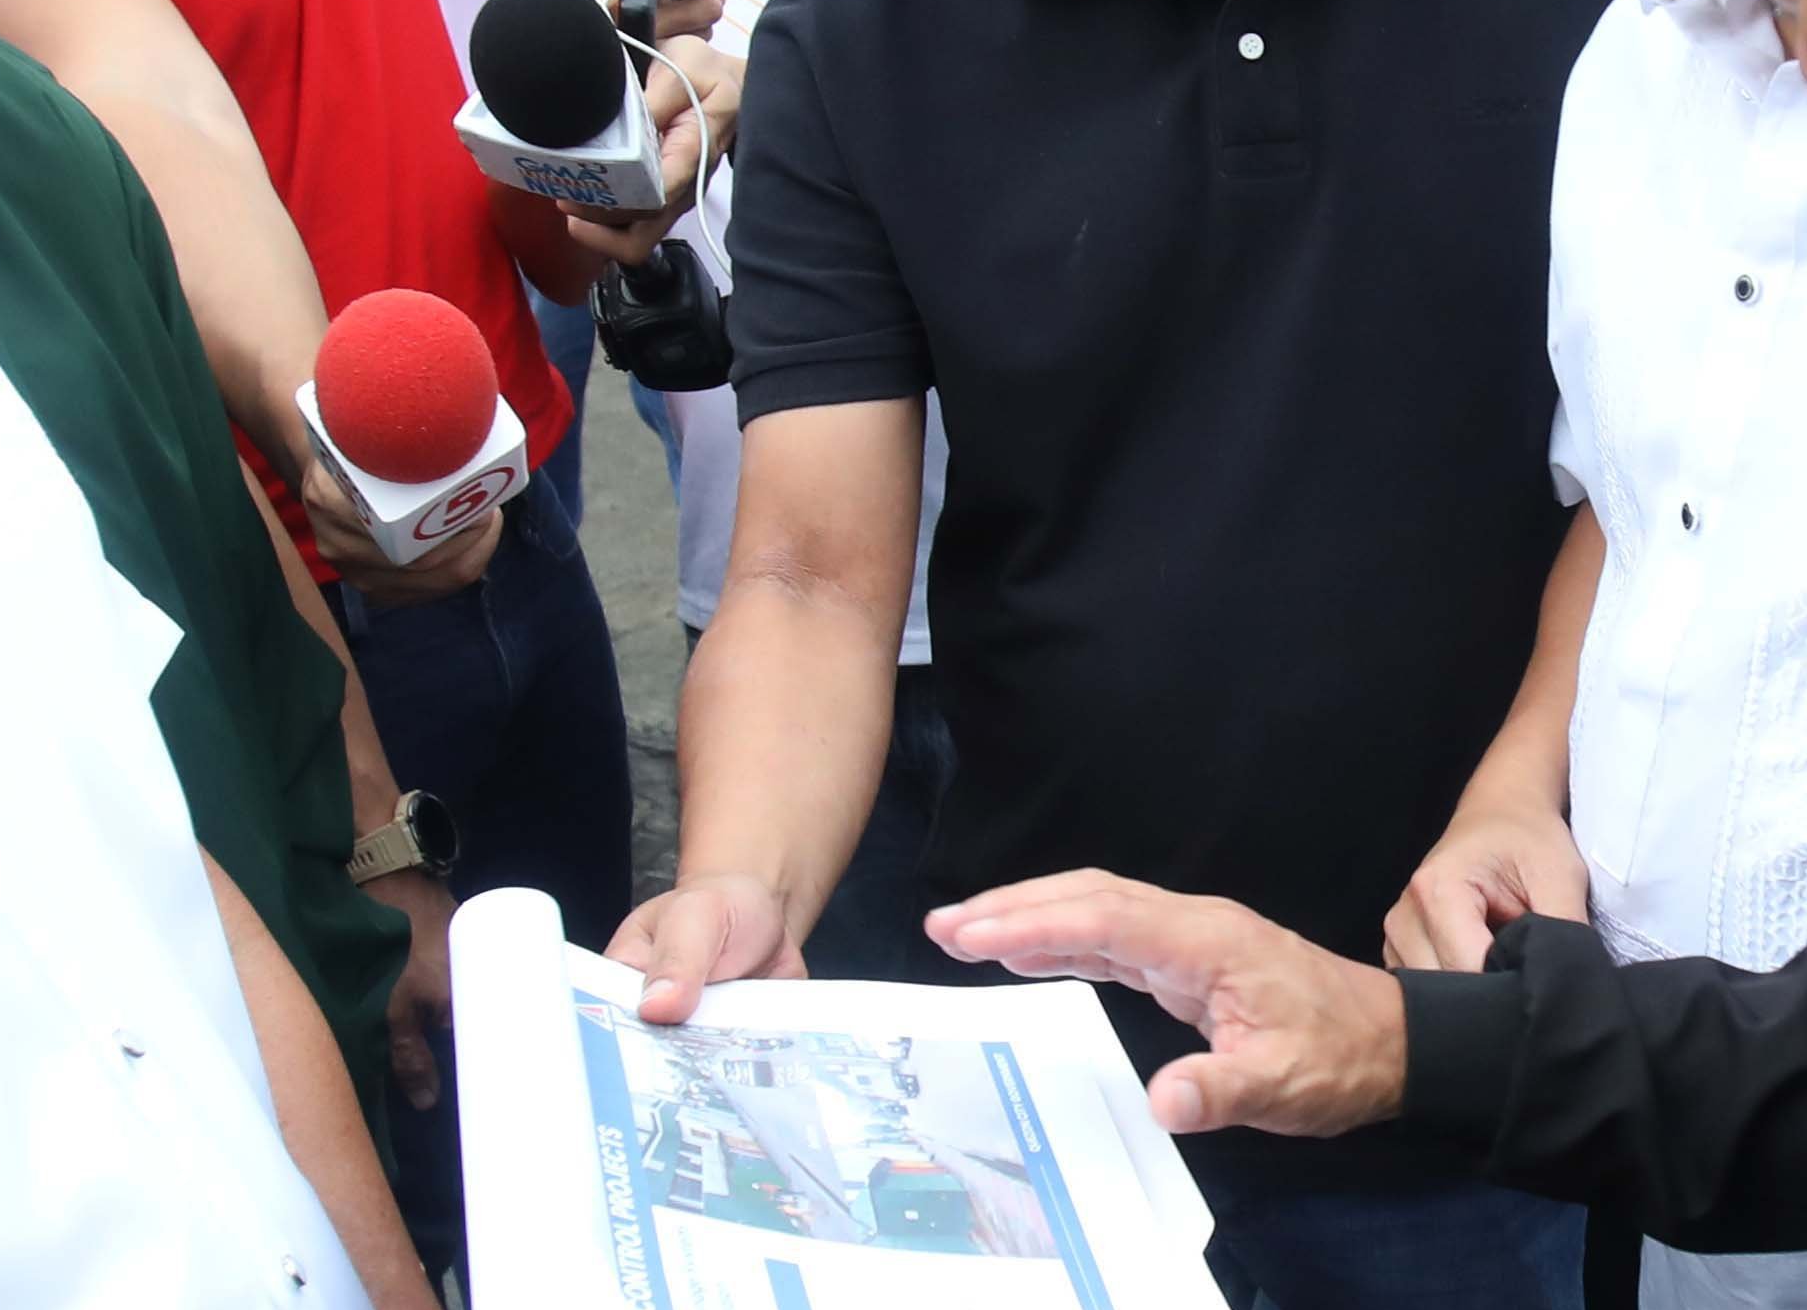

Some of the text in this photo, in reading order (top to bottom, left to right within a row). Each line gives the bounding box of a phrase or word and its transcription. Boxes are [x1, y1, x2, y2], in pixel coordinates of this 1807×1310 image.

[513, 157, 608, 183] GMA
[523, 176, 619, 207] NEWS
[442, 480, 489, 527] 5
[596, 1123, 639, 1223] PROJECTS
